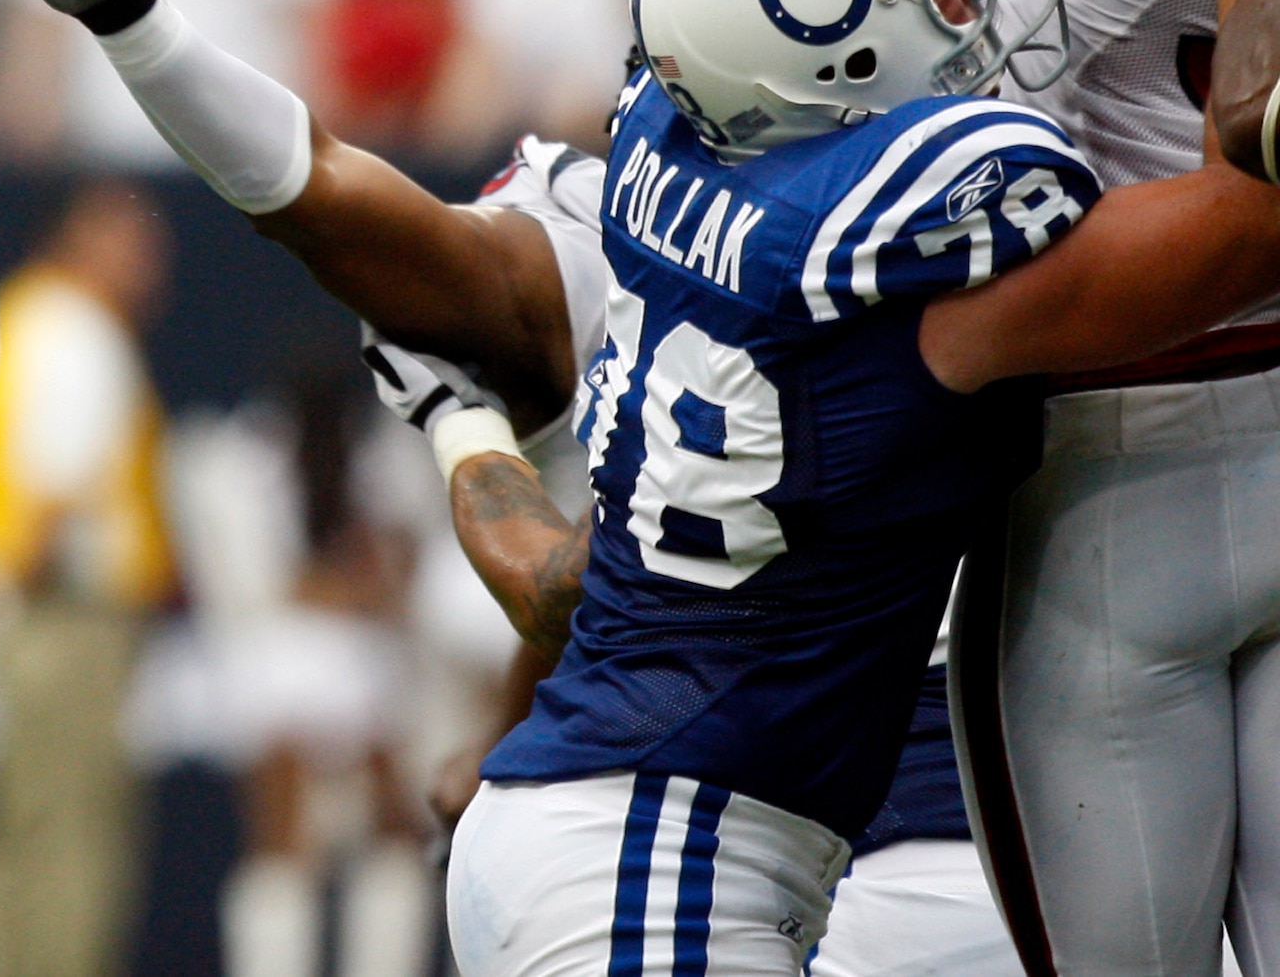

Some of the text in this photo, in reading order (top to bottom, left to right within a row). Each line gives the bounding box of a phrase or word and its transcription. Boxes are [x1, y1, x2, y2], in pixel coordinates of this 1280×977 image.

[610, 137, 765, 293] POLLAK
[914, 168, 1083, 289] 78
[589, 285, 788, 590] 78
